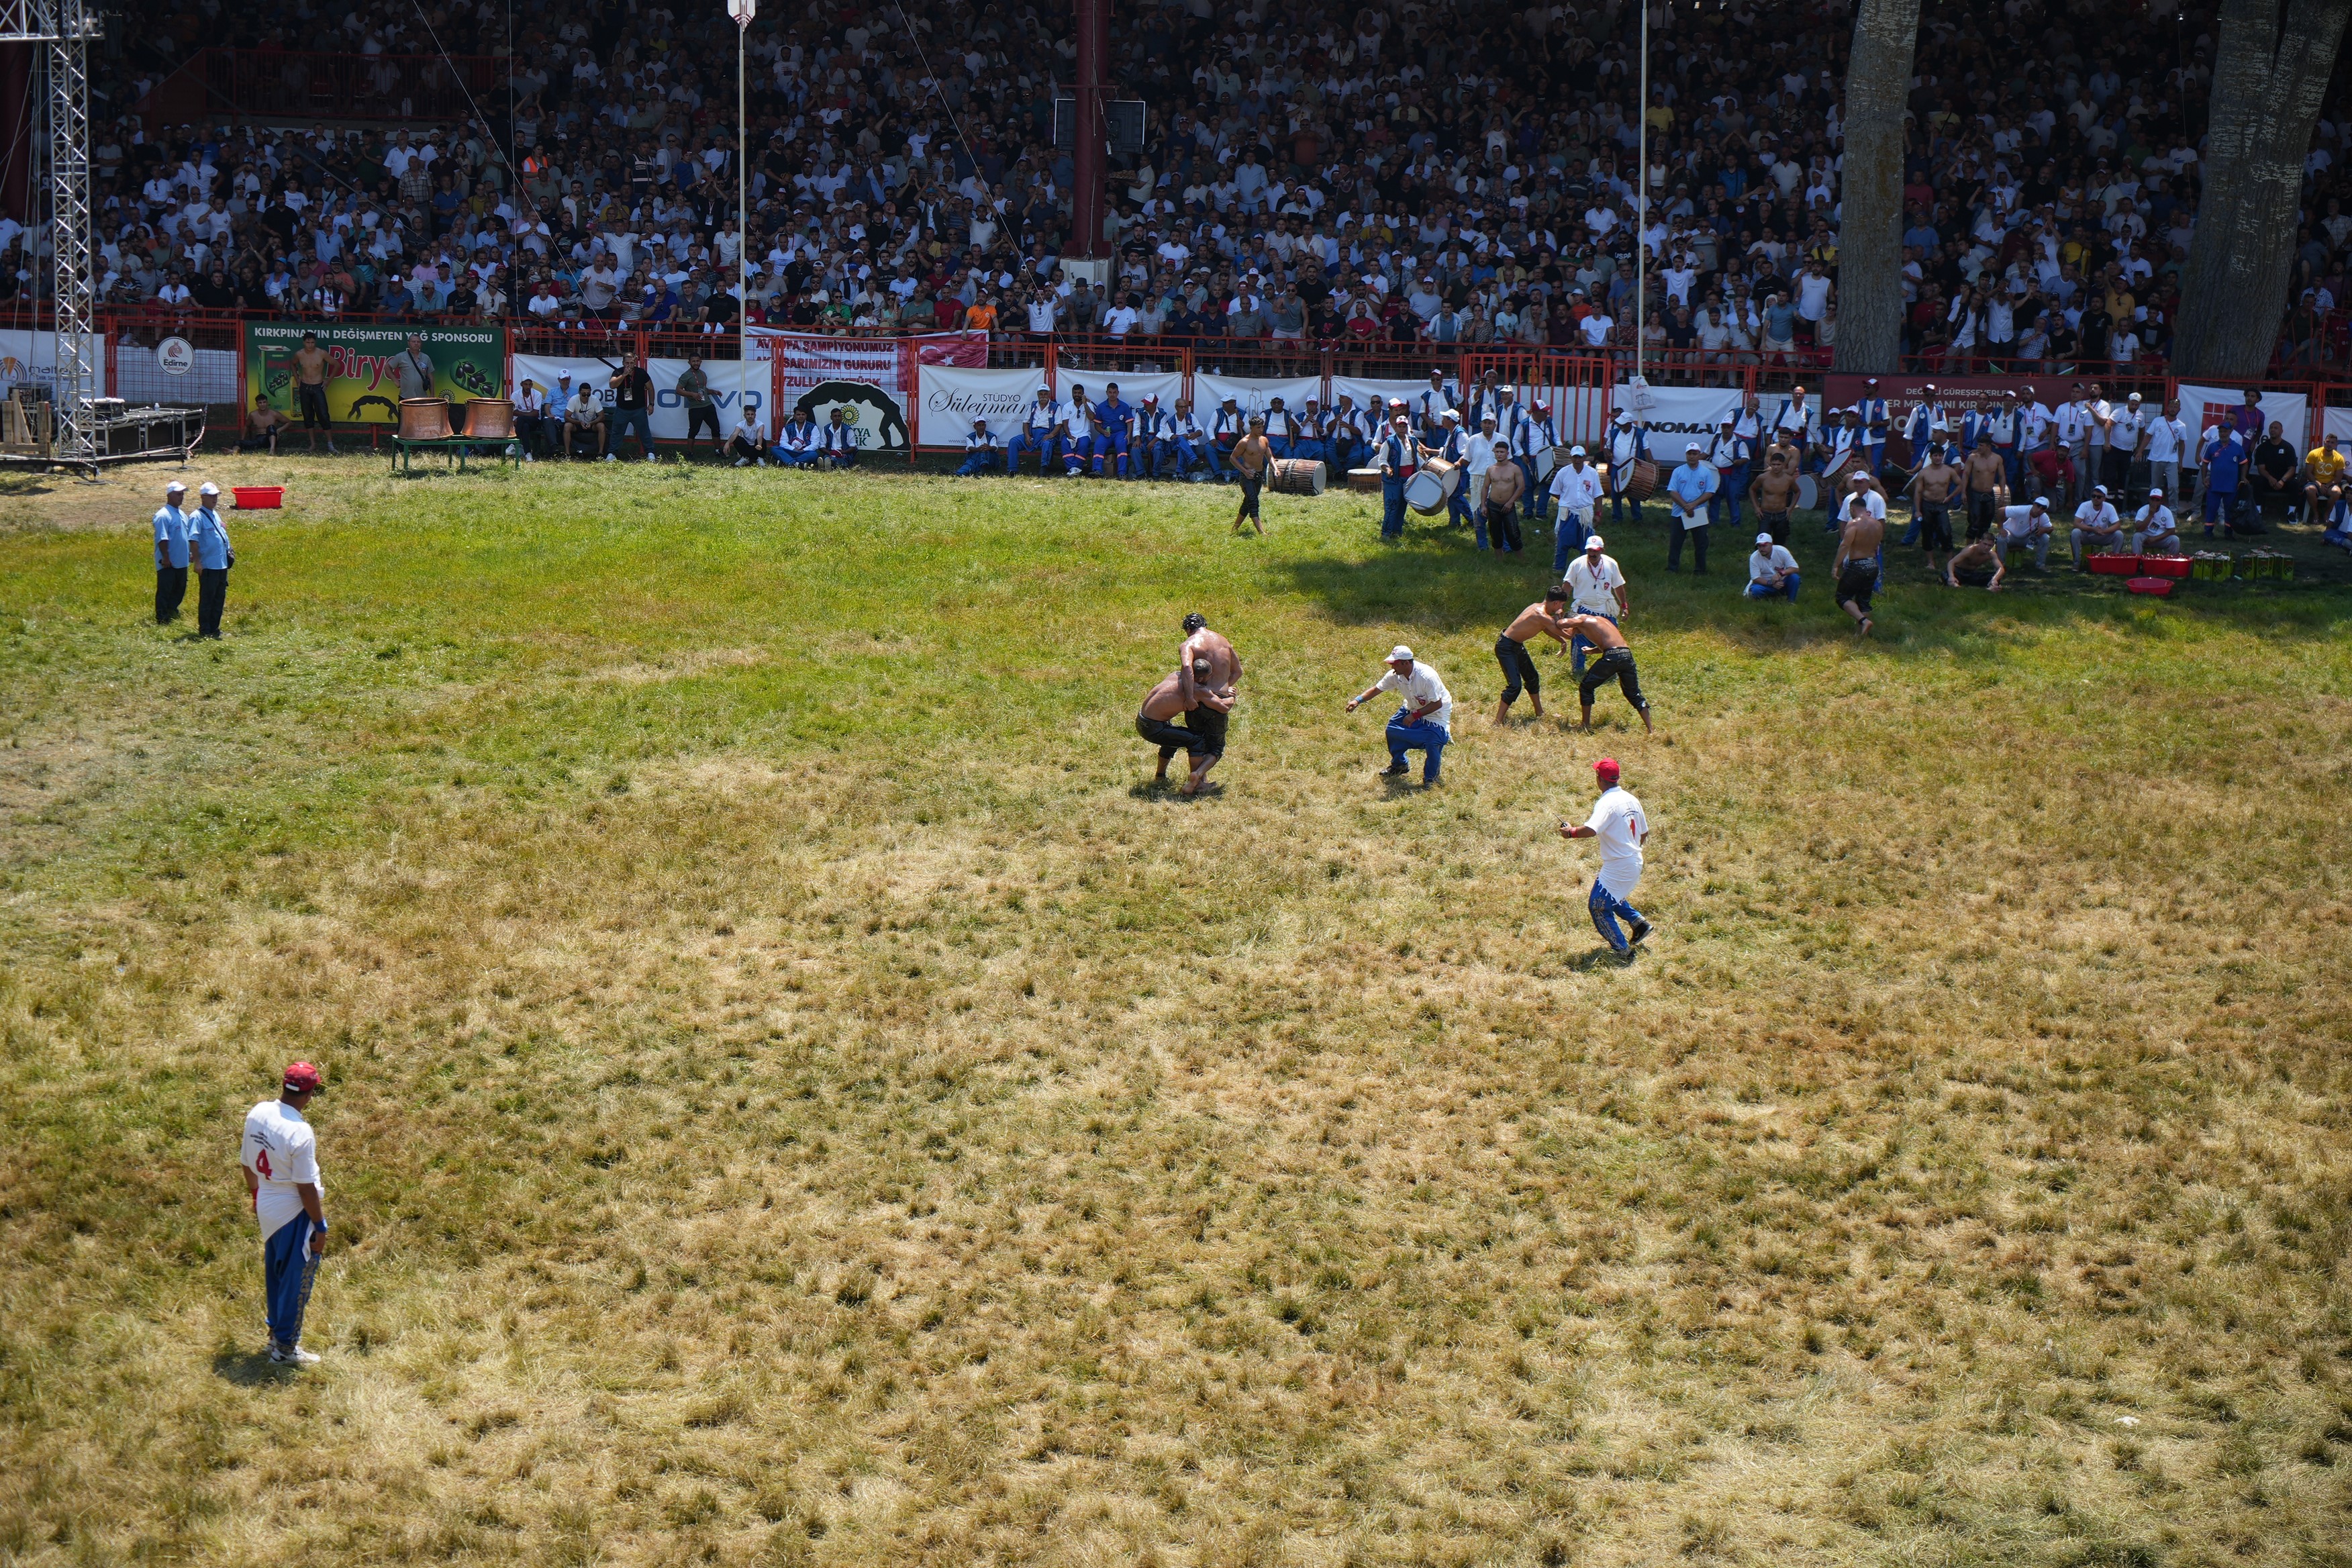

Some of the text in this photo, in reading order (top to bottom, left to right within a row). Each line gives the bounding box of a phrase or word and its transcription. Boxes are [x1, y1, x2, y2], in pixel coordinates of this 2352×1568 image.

[334, 328, 402, 342] DEĞİŞMEYEN
[432, 333, 493, 343] SPONSORU
[803, 340, 894, 353] ŞAMPİYONUMUZ
[844, 360, 891, 371] GURURU
[983, 393, 1021, 402] STÜDYO
[256, 1148, 273, 1181] 4
